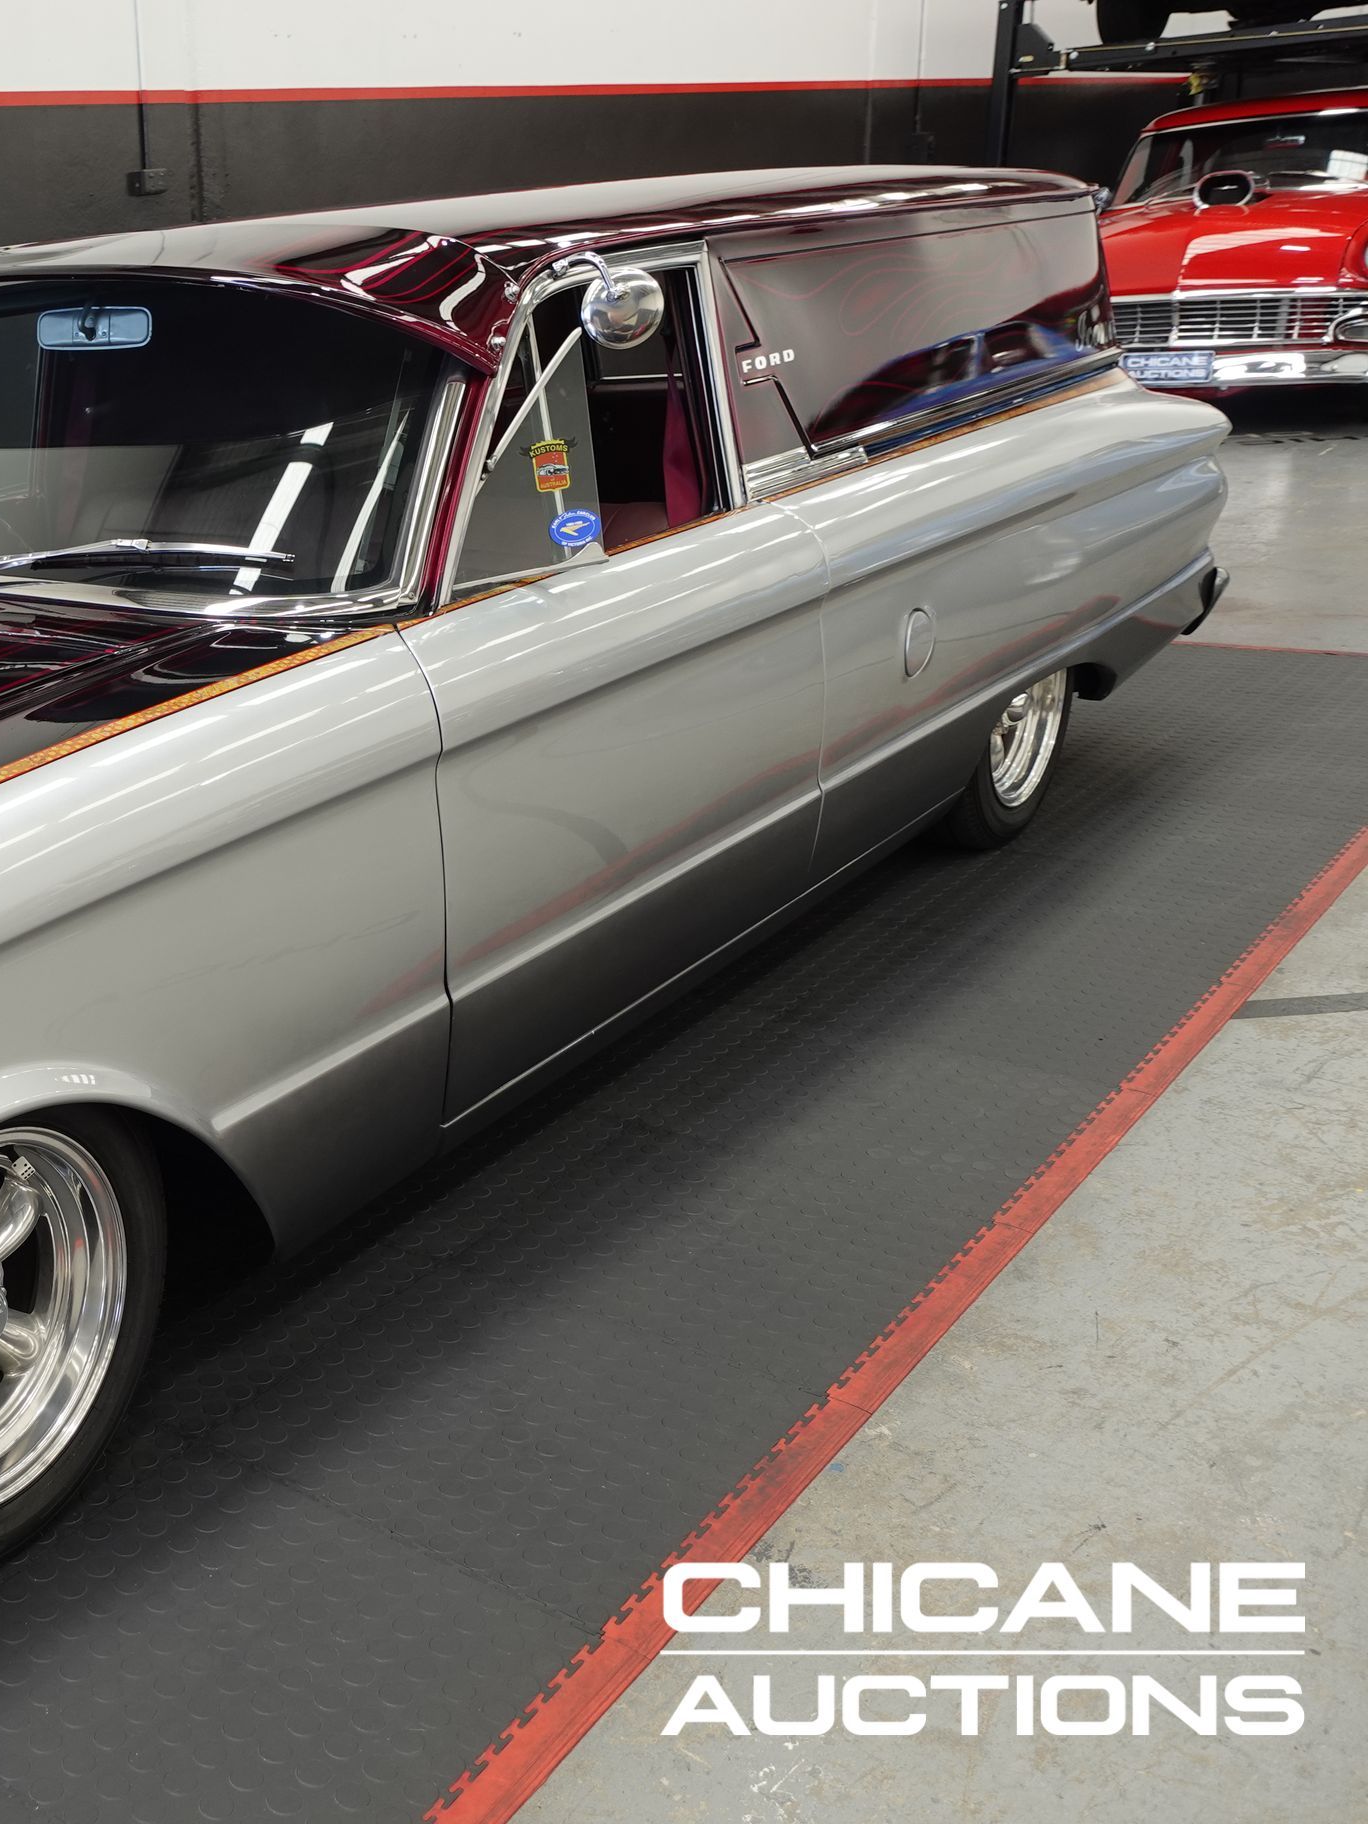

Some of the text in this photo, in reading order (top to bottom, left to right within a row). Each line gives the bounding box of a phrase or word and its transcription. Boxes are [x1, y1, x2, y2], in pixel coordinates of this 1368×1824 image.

[741, 349, 795, 373] FORD
[1127, 356, 1209, 368] CHICANE
[529, 445, 568, 458] KUSTOMS
